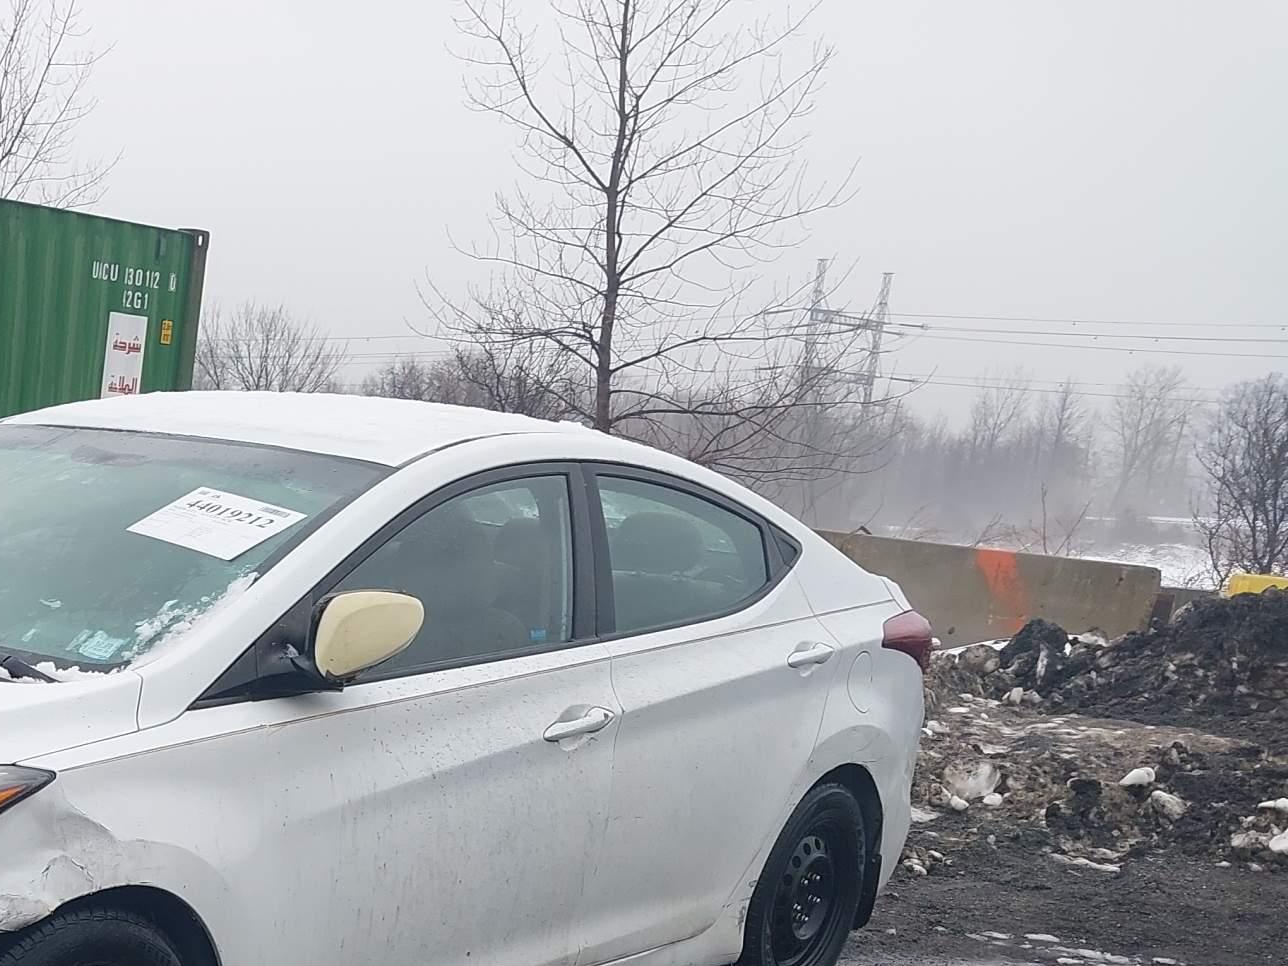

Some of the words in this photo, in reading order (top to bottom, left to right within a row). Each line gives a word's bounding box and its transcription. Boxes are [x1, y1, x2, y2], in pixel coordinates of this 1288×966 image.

[92, 260, 119, 281] UICU
[124, 267, 160, 289] 130112
[122, 290, 149, 310] 12G1
[187, 500, 275, 529] 44019212
